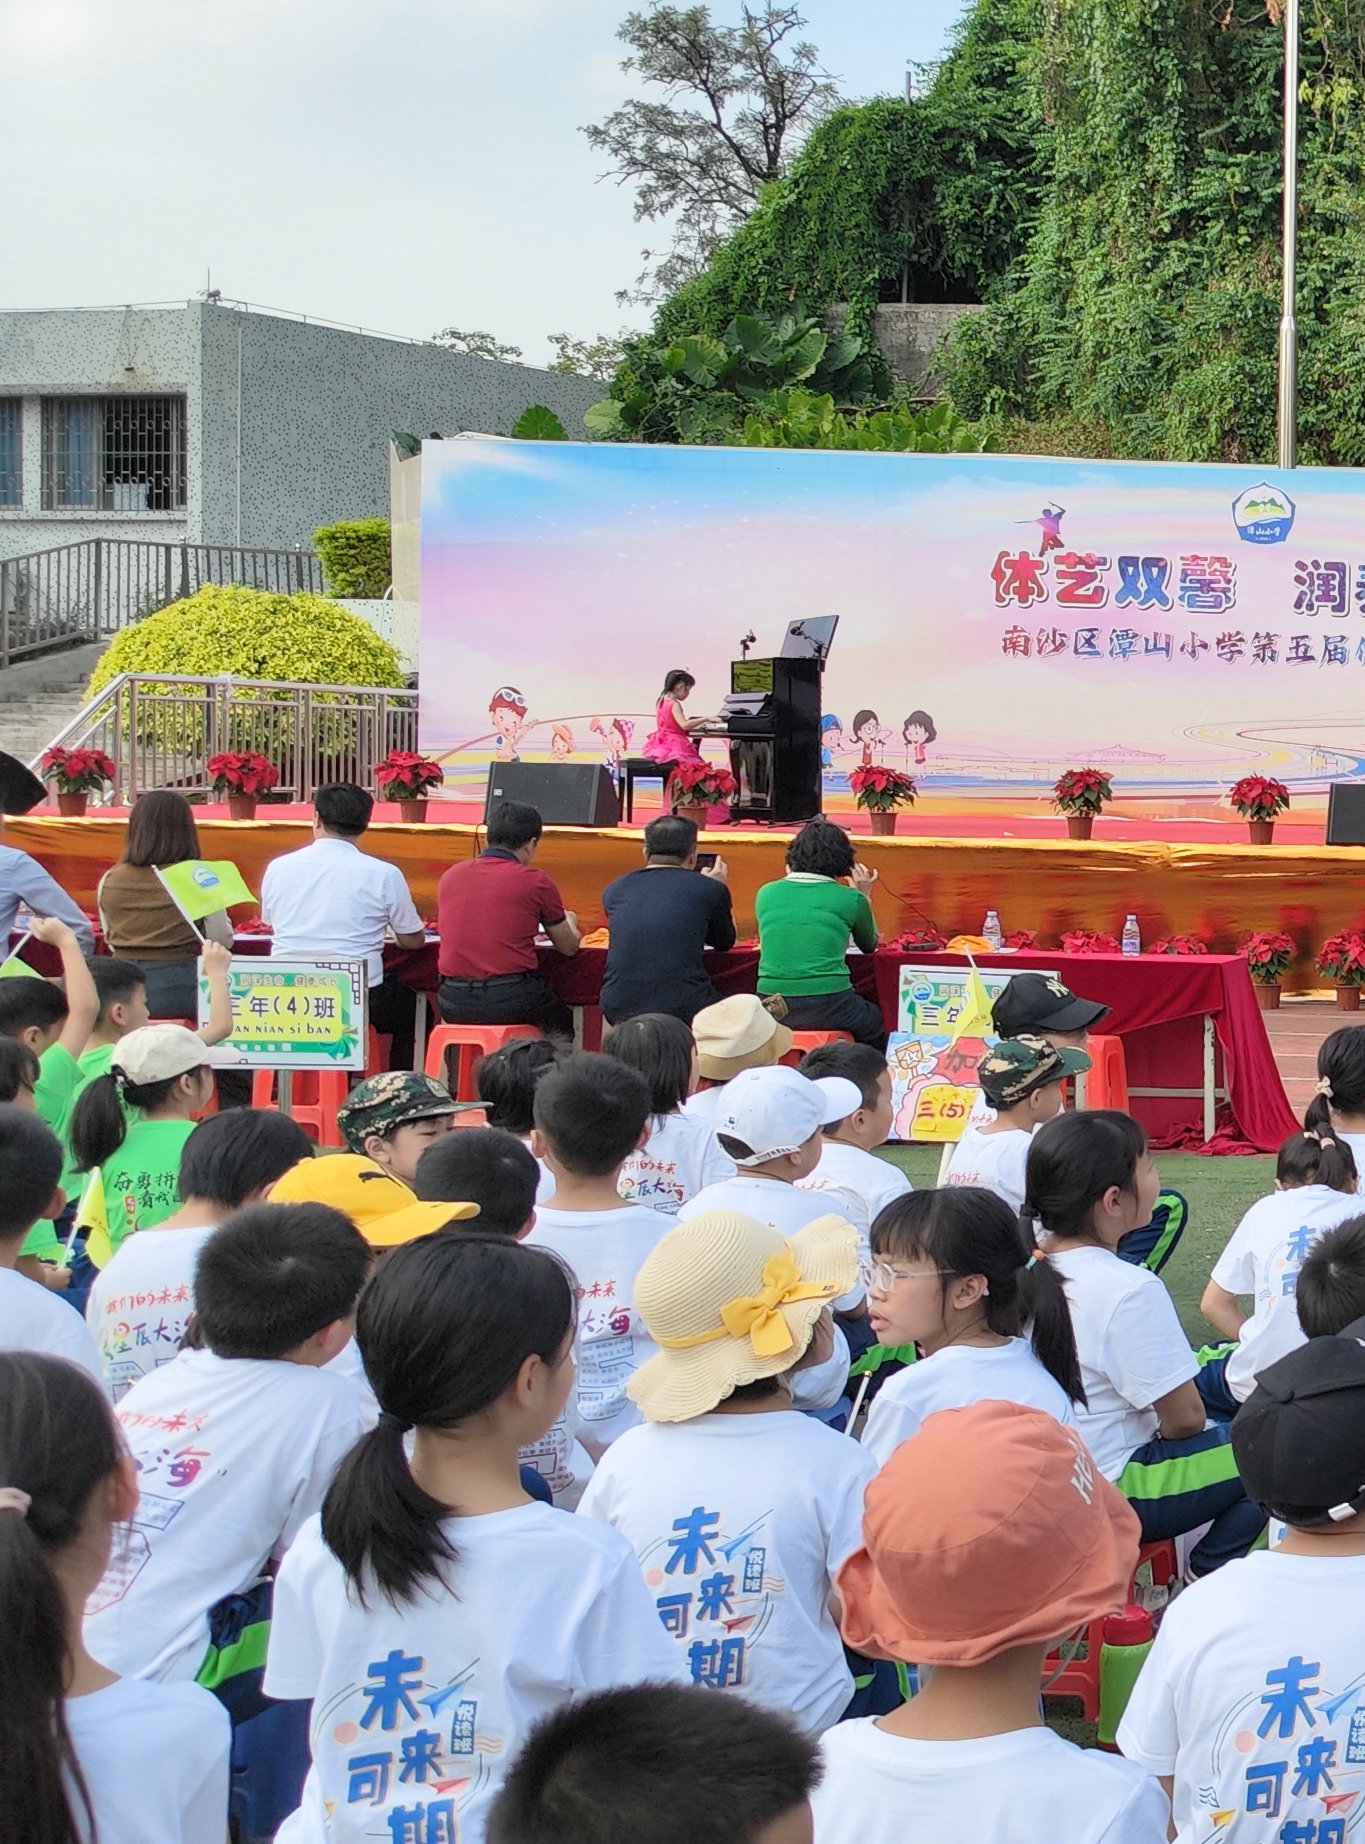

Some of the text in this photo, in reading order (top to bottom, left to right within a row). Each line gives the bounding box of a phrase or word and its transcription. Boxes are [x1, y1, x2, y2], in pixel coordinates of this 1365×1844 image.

[992, 550, 1237, 611] 体艺双馨
[113, 1170, 182, 1192] 奋勇拼
